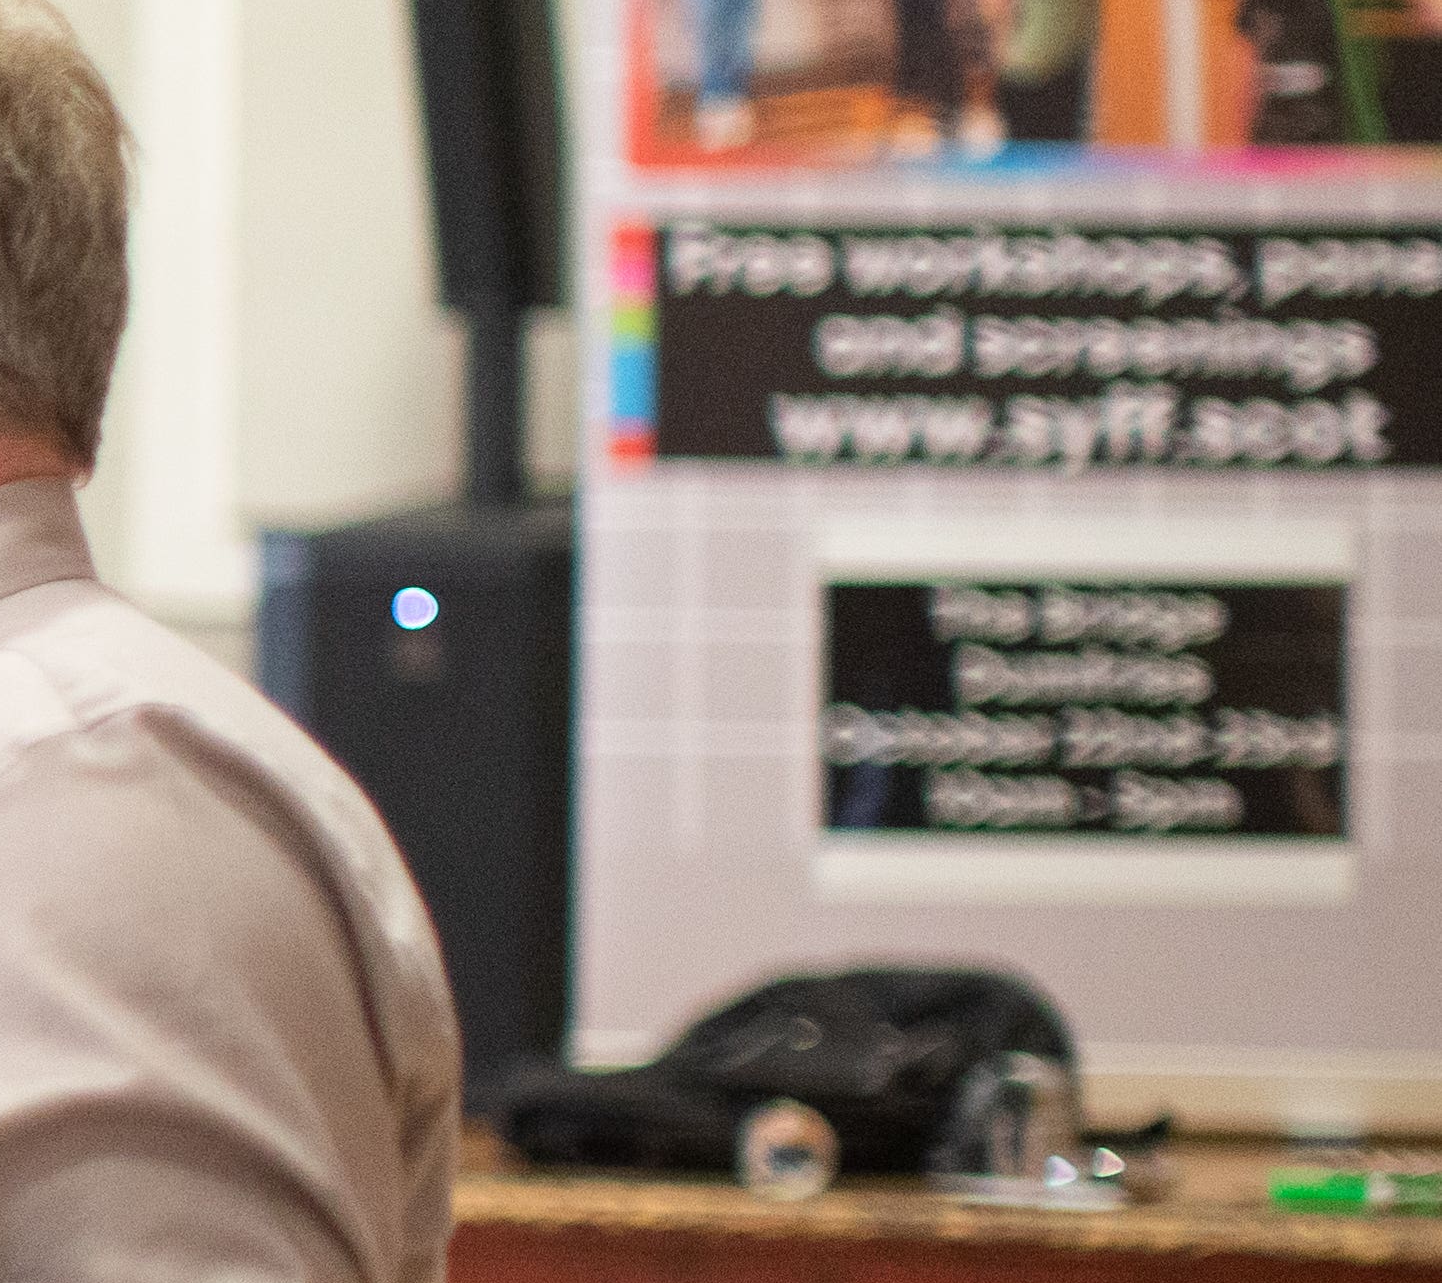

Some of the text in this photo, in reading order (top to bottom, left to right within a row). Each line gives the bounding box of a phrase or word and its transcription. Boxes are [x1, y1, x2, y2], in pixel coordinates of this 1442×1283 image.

[673, 226, 835, 297] Free
[844, 228, 1248, 308] workshops,
[815, 308, 1379, 392] and screenings
[771, 384, 1389, 473] www.syff.scot
[933, 586, 1030, 642] The
